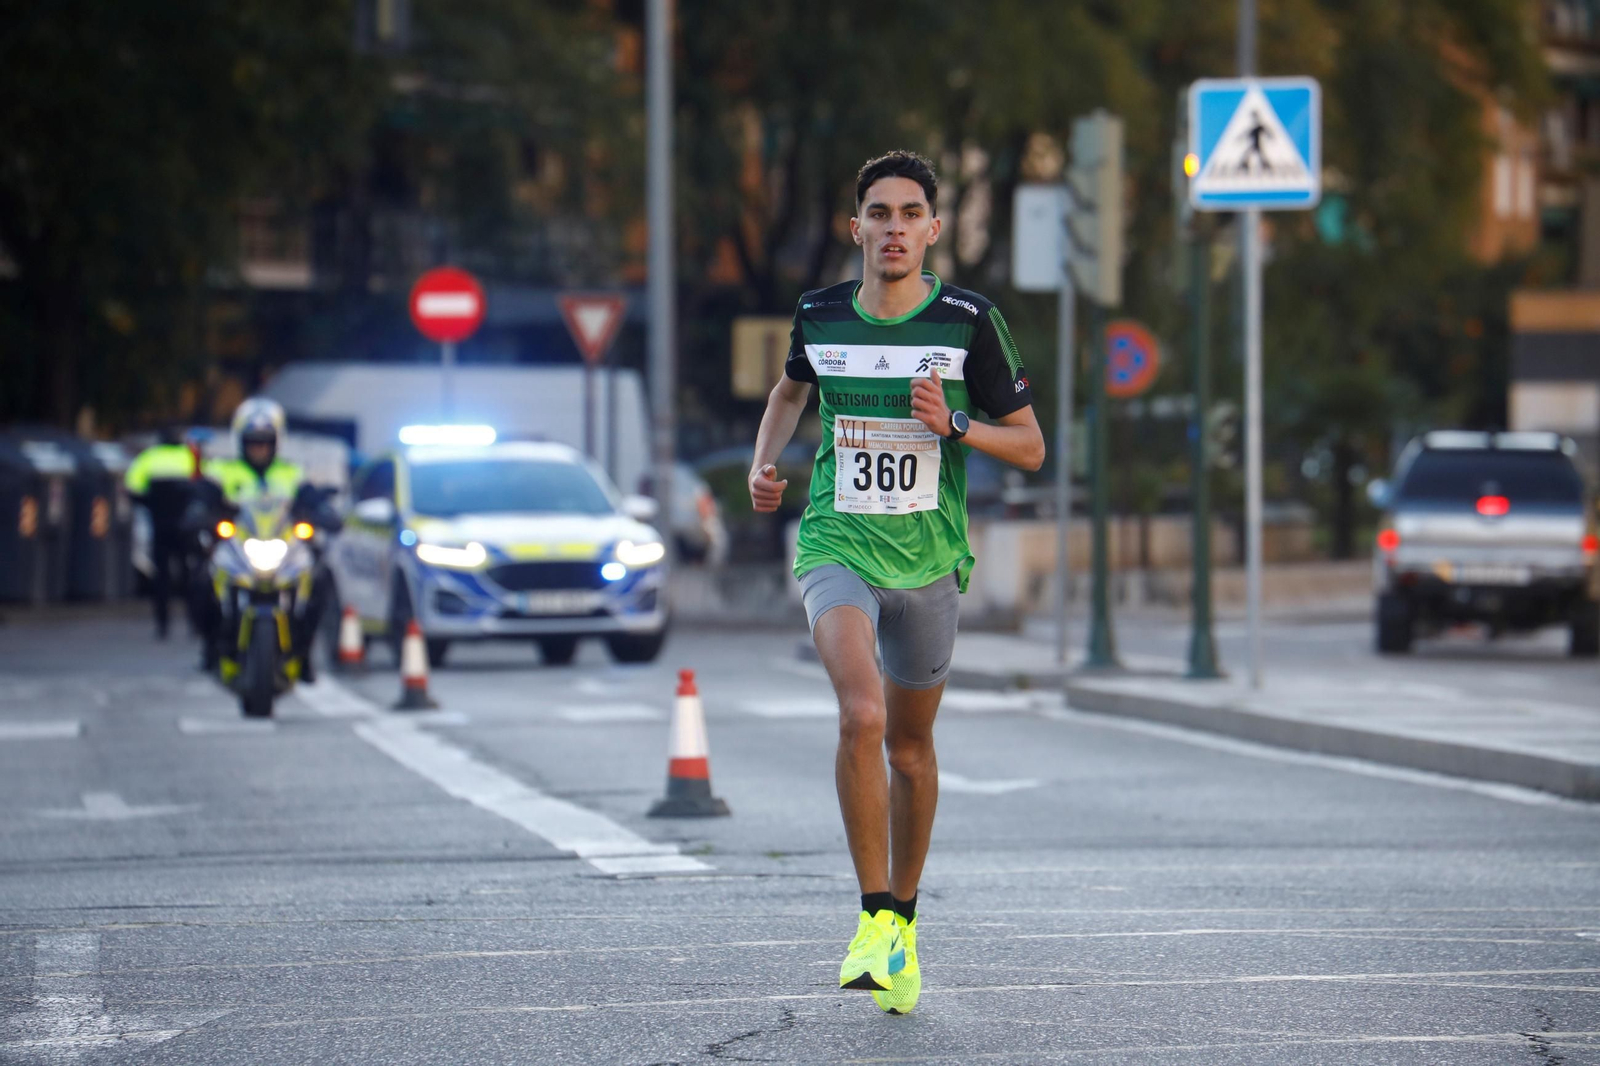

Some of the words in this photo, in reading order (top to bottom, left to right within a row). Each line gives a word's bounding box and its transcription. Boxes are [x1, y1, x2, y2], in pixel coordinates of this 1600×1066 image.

[942, 296, 979, 315] DECATHLON
[839, 420, 867, 448] XLI
[880, 422, 901, 430] CARRERA
[868, 441, 893, 450] MEMORIAL
[853, 451, 918, 492] 360
